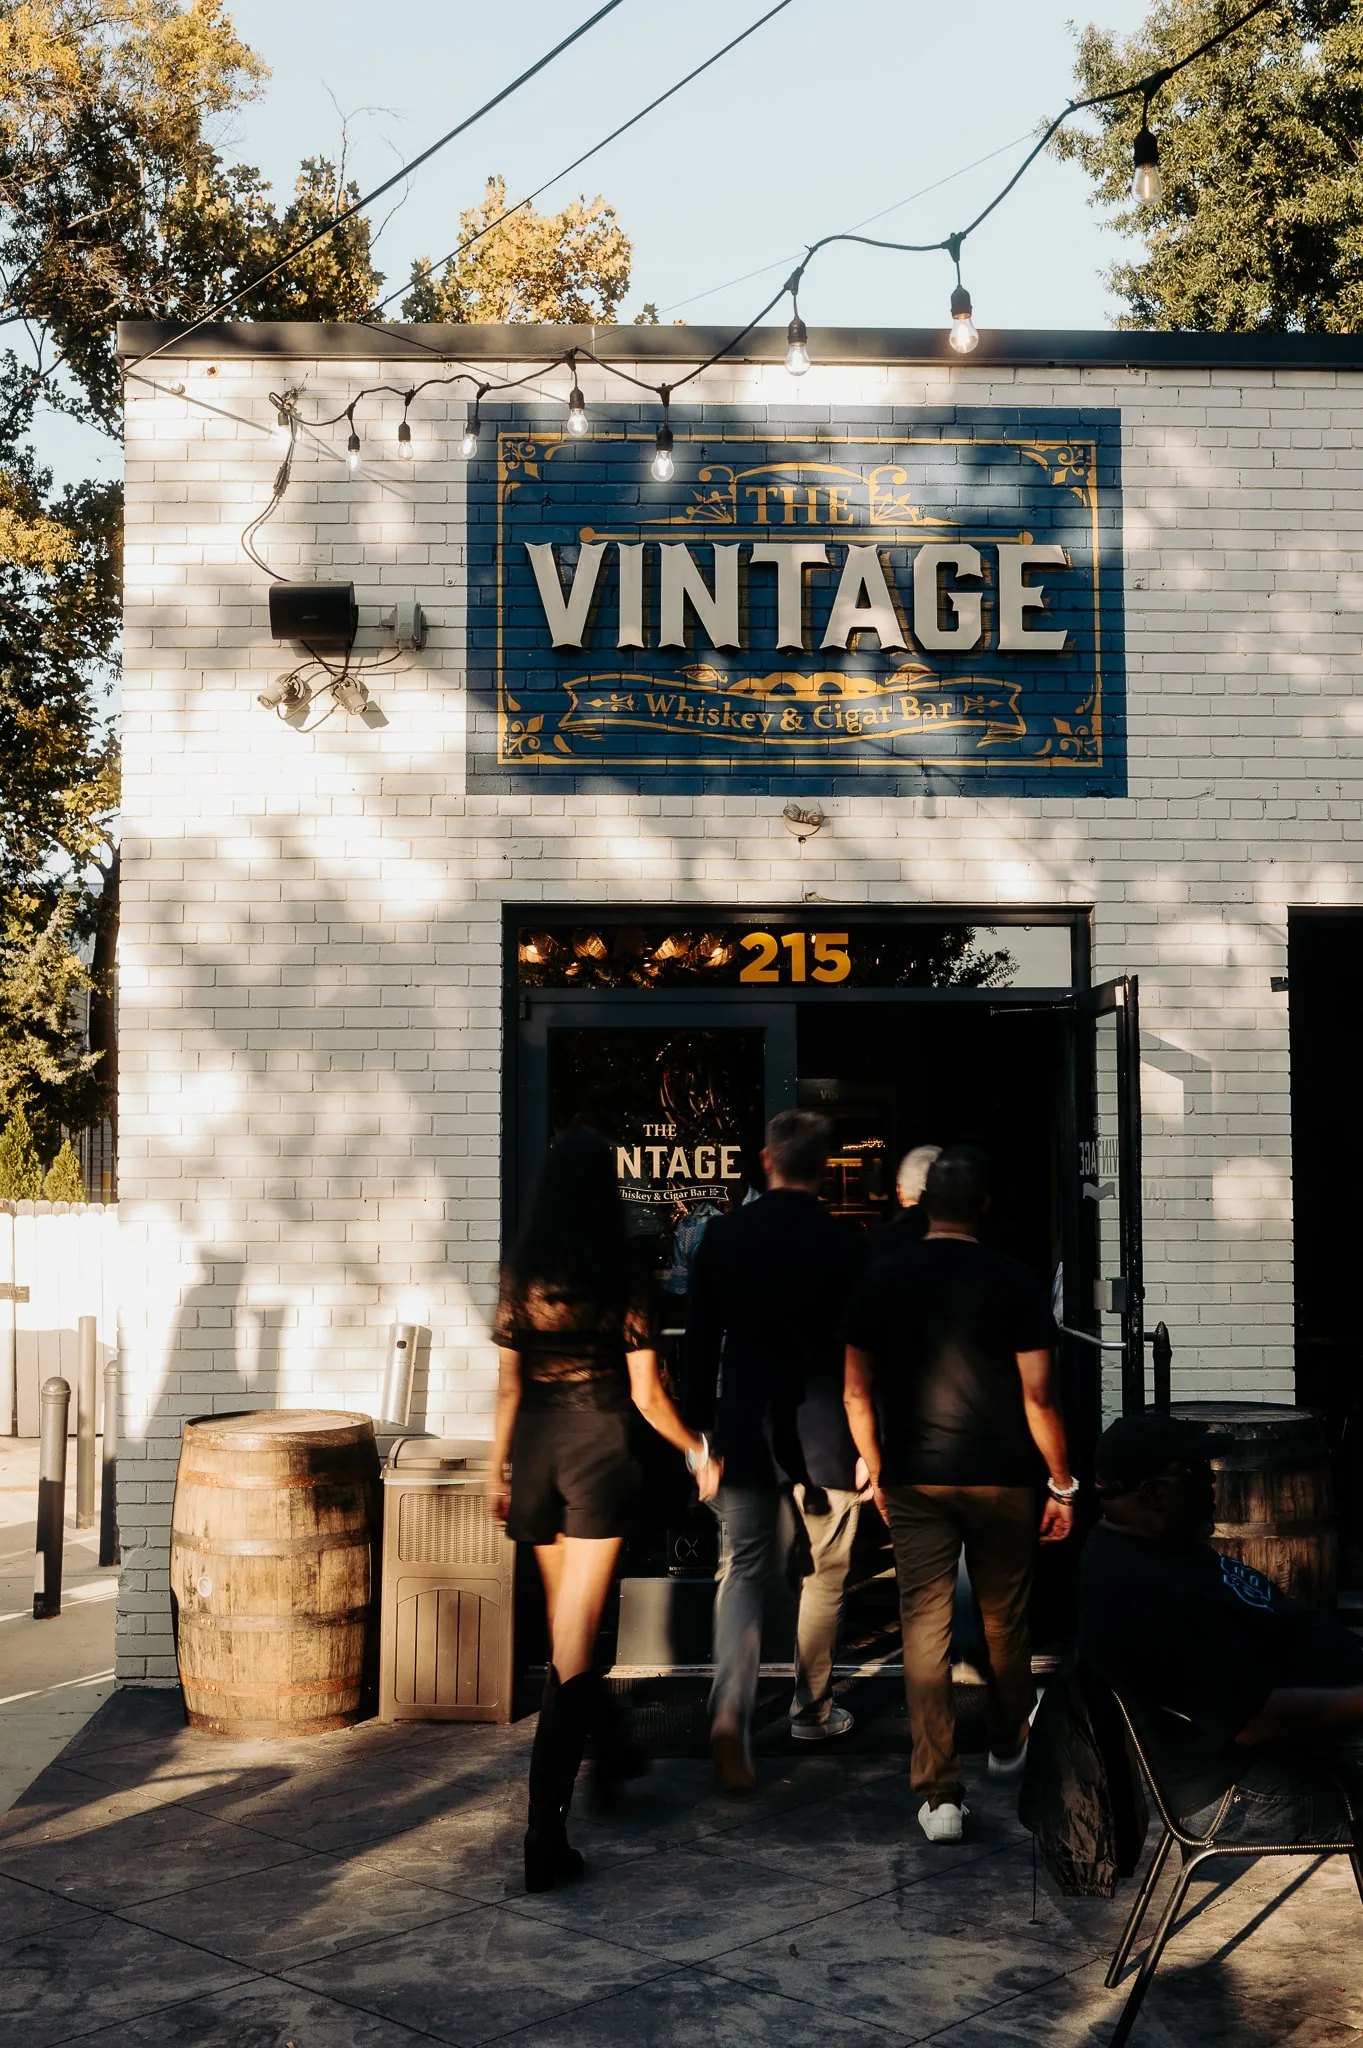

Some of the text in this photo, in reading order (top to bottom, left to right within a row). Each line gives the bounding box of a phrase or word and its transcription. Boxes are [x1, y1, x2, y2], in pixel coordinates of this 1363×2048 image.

[745, 486, 854, 525] THE
[524, 541, 1069, 652] VINTAGE
[645, 693, 953, 736] Whiskey & Cigar Bar
[740, 931, 851, 983] 215
[643, 1123, 677, 1137] THE
[616, 1145, 742, 1179] NTAGE
[619, 1187, 707, 1202] hiskey & Cigar Bar
